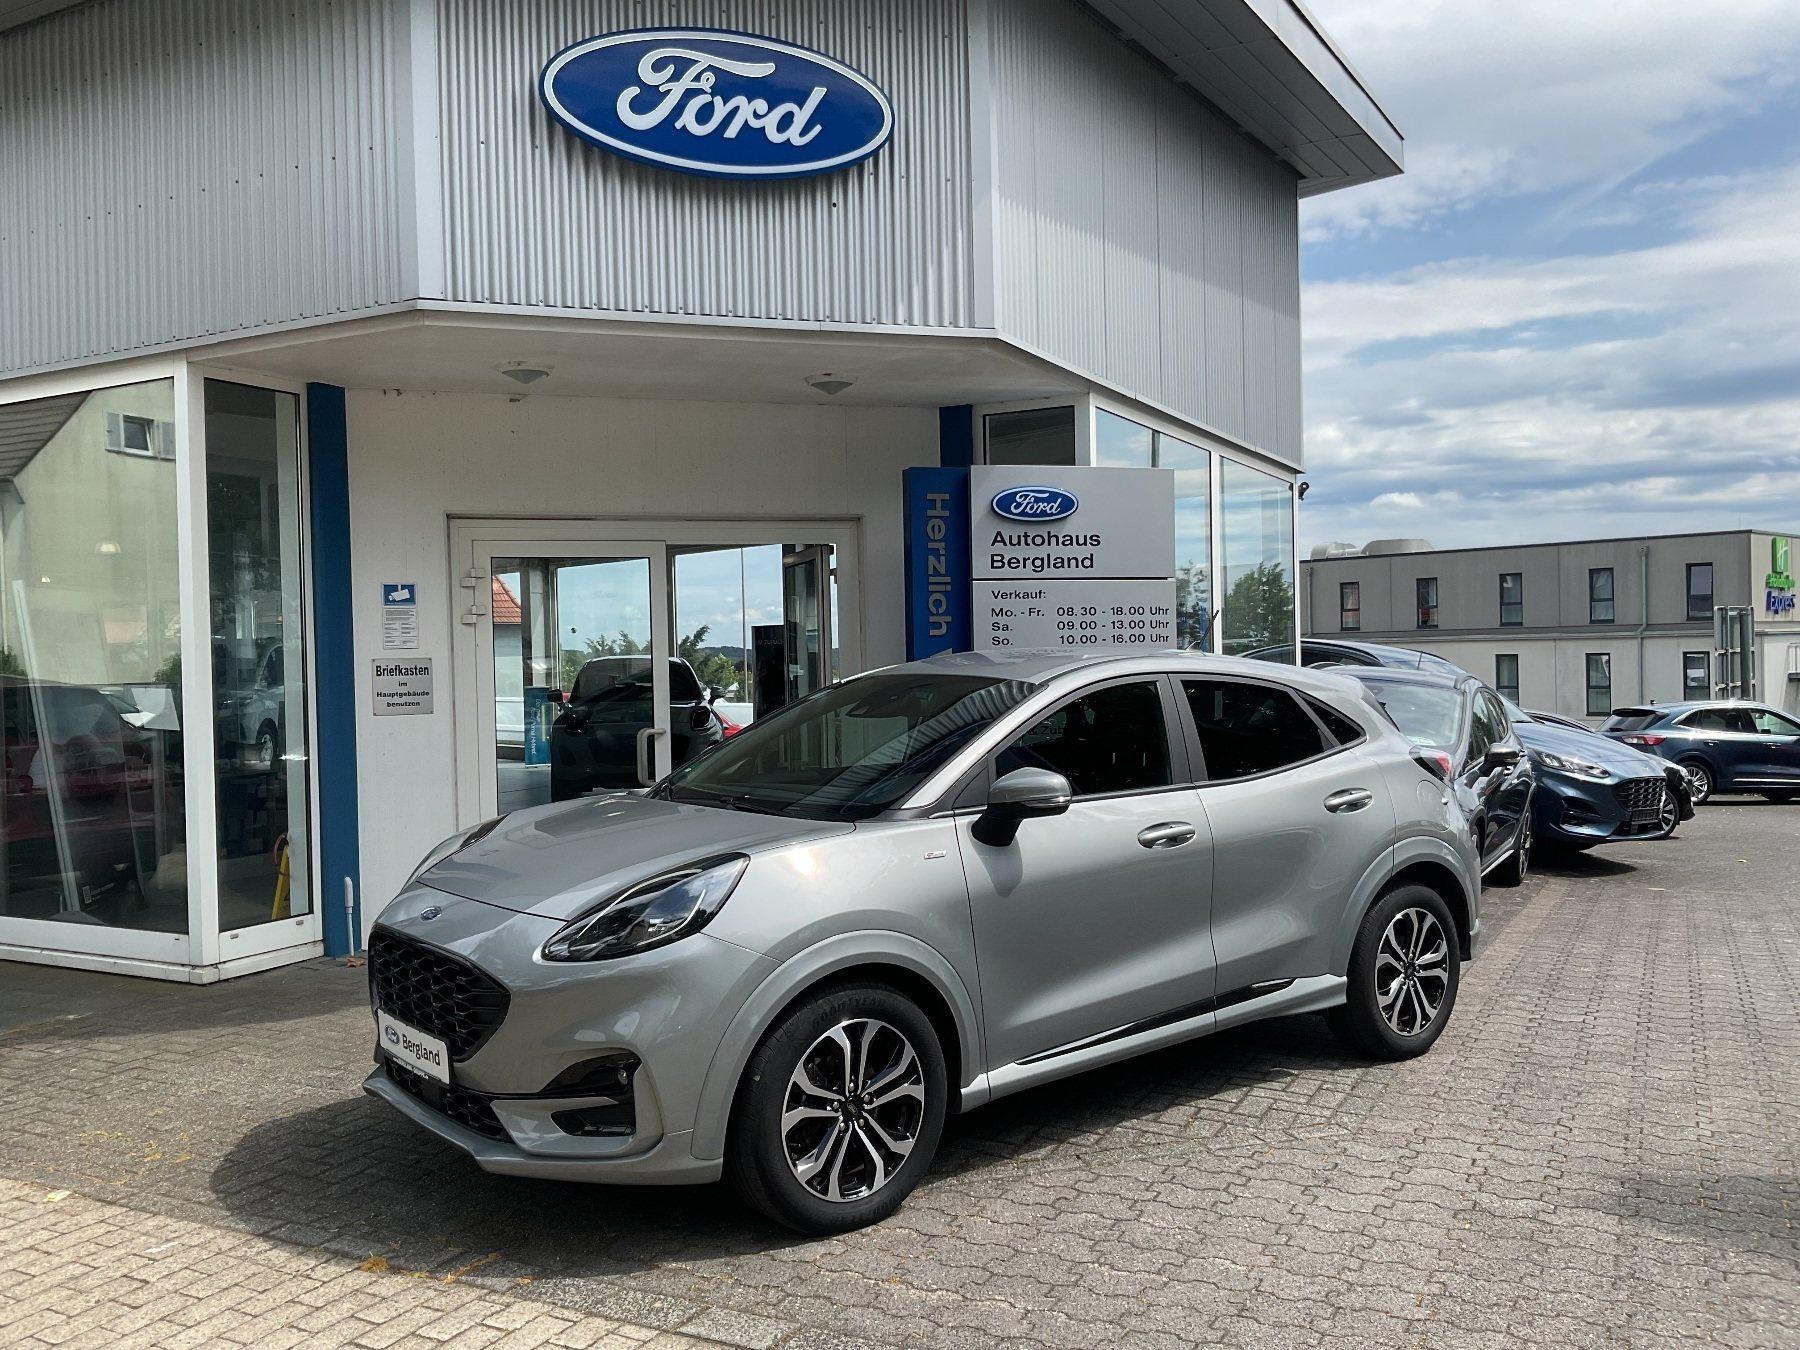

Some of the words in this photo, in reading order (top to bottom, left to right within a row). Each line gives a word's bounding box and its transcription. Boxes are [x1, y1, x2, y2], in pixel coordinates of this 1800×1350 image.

[617, 48, 827, 146] Ford
[1010, 492, 1061, 515] Ford
[990, 530, 1101, 547] Autohaus
[926, 492, 952, 636] Herzlich
[990, 553, 1094, 573] Bergland
[991, 590, 1046, 600] Verkauf:
[991, 608, 1017, 617] Mo.
[1028, 608, 1045, 617] Fr.
[1056, 606, 1097, 617] 08.30
[1110, 606, 1145, 616] 18.00
[1149, 606, 1170, 616] Uhr
[991, 622, 1013, 632] Sa.
[1056, 621, 1097, 630] 09.00
[1110, 620, 1145, 630] 13.00
[1149, 620, 1170, 629] Uhr
[991, 636, 1013, 646] So.
[1059, 634, 1097, 645] 10.00
[1110, 634, 1145, 644] 16.00
[1149, 634, 1170, 643] Uhr
[375, 665, 429, 677] Briefkasten
[376, 690, 430, 699] Hauptgebäude
[402, 1034, 441, 1066] Bergland
